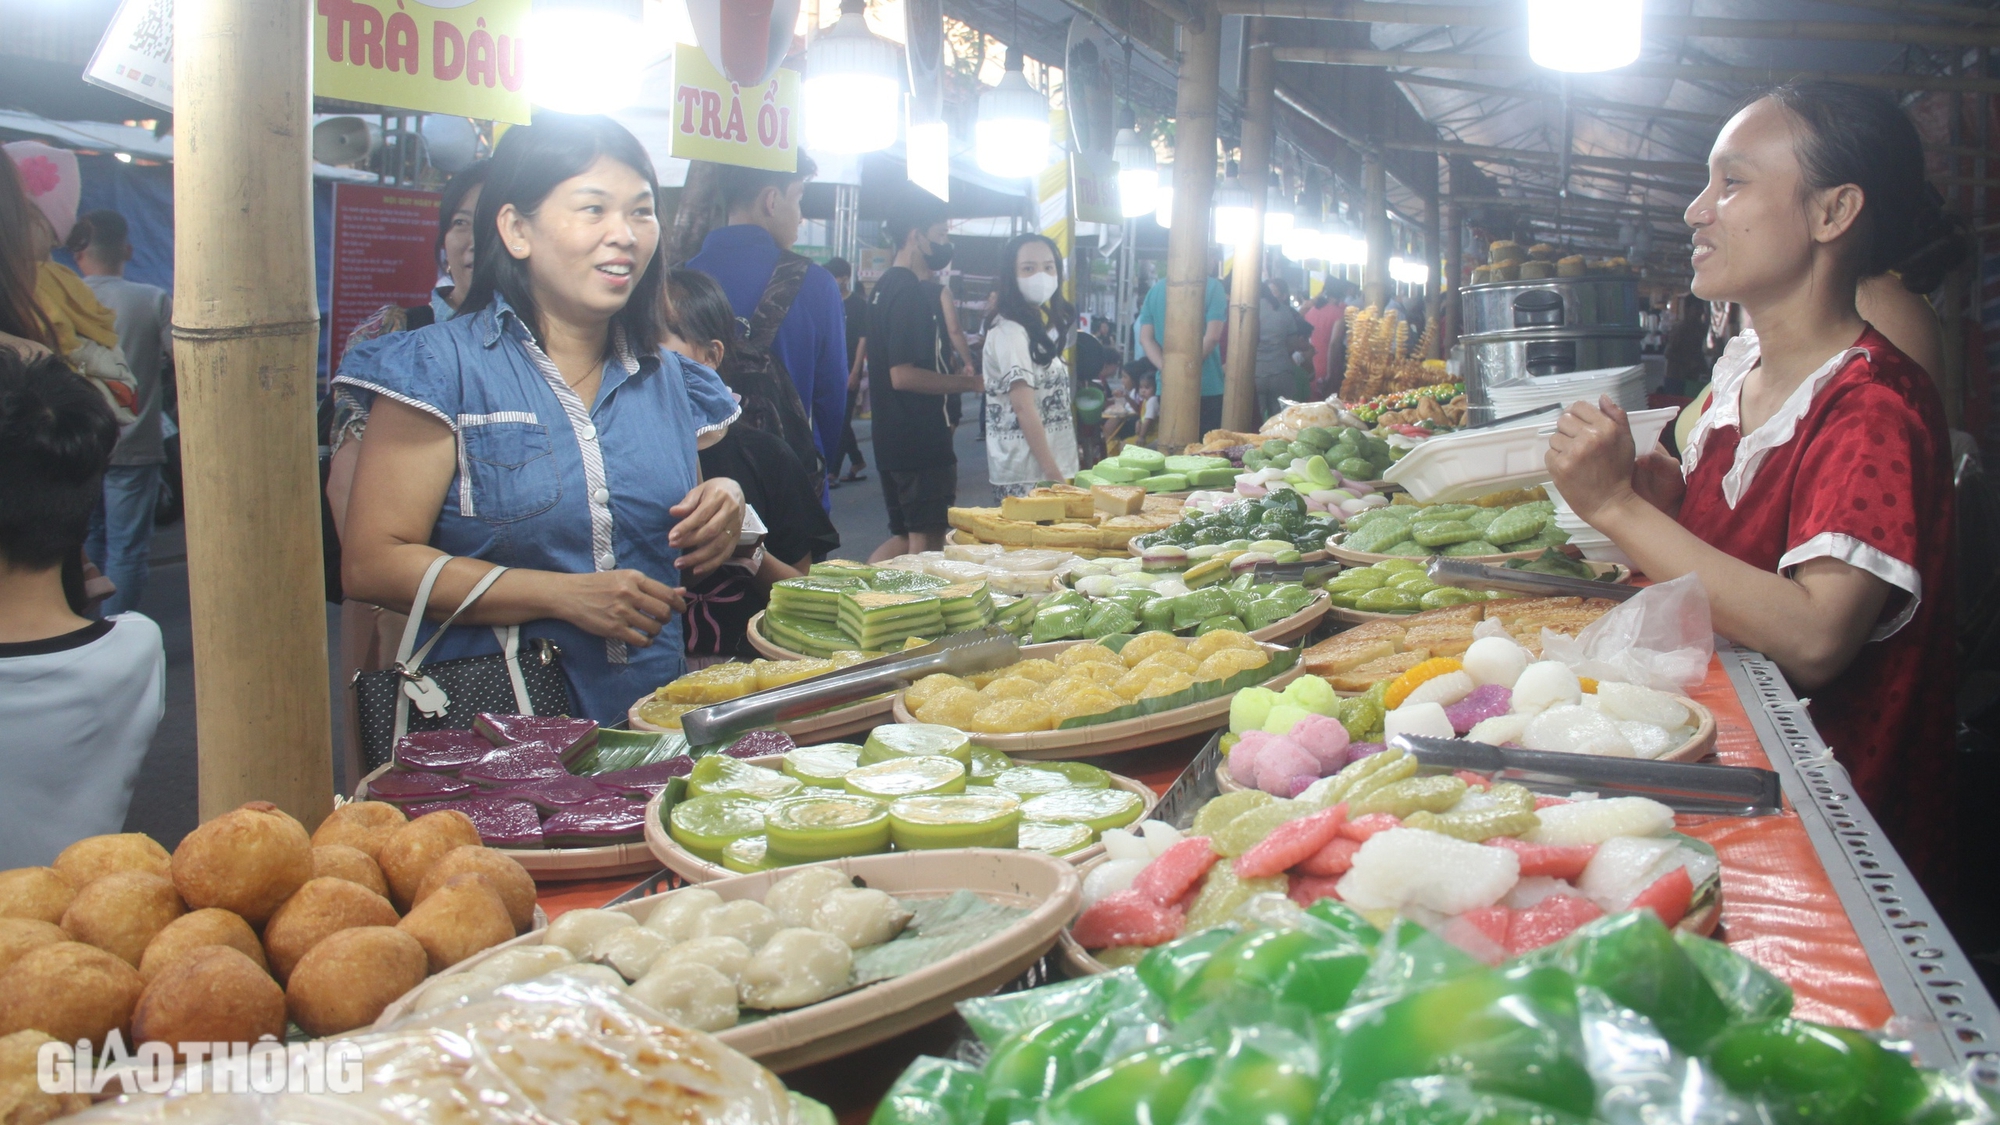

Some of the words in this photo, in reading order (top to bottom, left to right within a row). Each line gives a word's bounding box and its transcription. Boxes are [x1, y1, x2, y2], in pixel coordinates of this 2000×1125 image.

[318, 0, 419, 75] TRÀ
[433, 16, 524, 92] DÂU
[677, 82, 748, 143] TRÀ
[757, 79, 790, 150] ỔI
